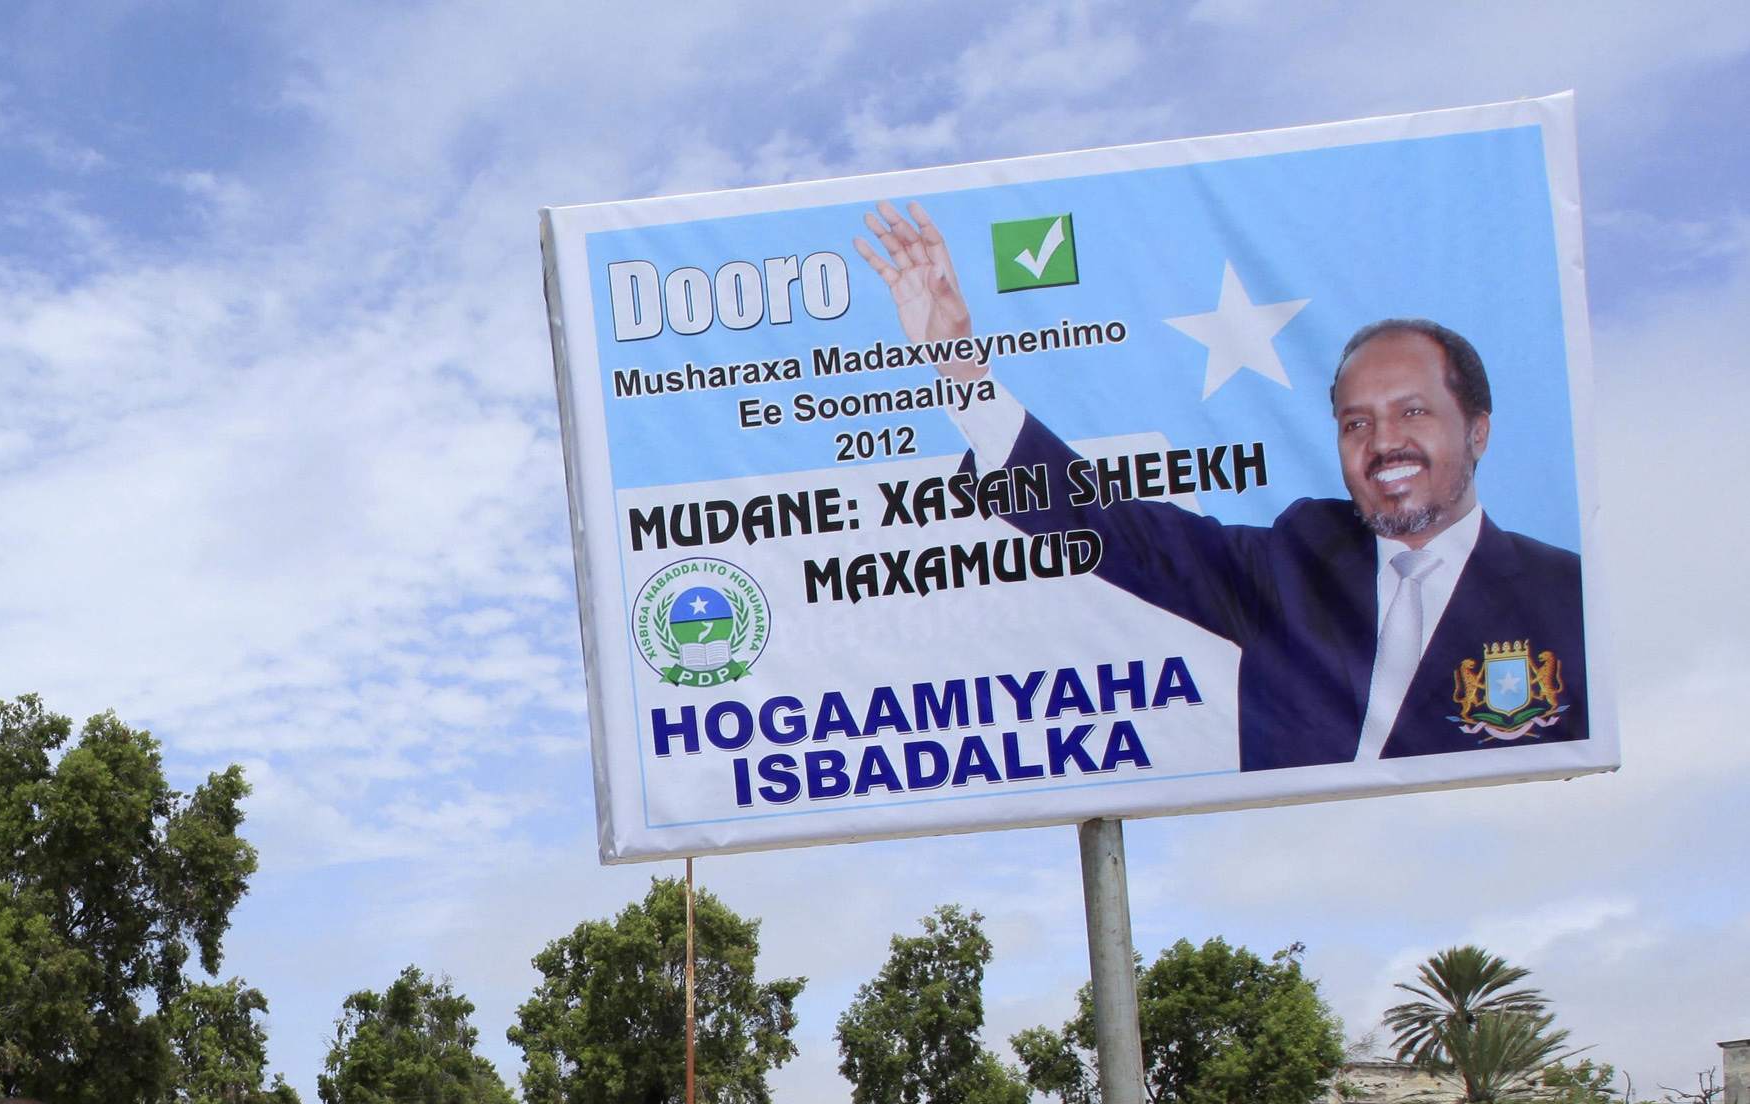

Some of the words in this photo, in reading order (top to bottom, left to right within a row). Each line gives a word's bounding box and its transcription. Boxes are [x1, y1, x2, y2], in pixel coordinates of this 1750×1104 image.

[608, 251, 851, 342] Dooro
[613, 357, 802, 398] Musharaxa
[813, 320, 1128, 378] Madaxweynenimo
[739, 398, 783, 429] Ee
[793, 375, 997, 424] Soomaaliya
[835, 427, 917, 462] 2012
[628, 487, 860, 551] MUDANE:
[878, 463, 1051, 528] XASAN
[1067, 441, 1269, 509] SHEEKH
[645, 562, 700, 603] NABADDA
[703, 562, 728, 576] IYO
[803, 529, 1104, 604] MAXAMUUD
[638, 605, 658, 660] XISBIGA
[730, 571, 765, 651] HORUMARKA
[650, 656, 1204, 757] HOGAAMIYAHA
[677, 667, 730, 686] PDP
[733, 721, 1152, 807] ISBADALKA
